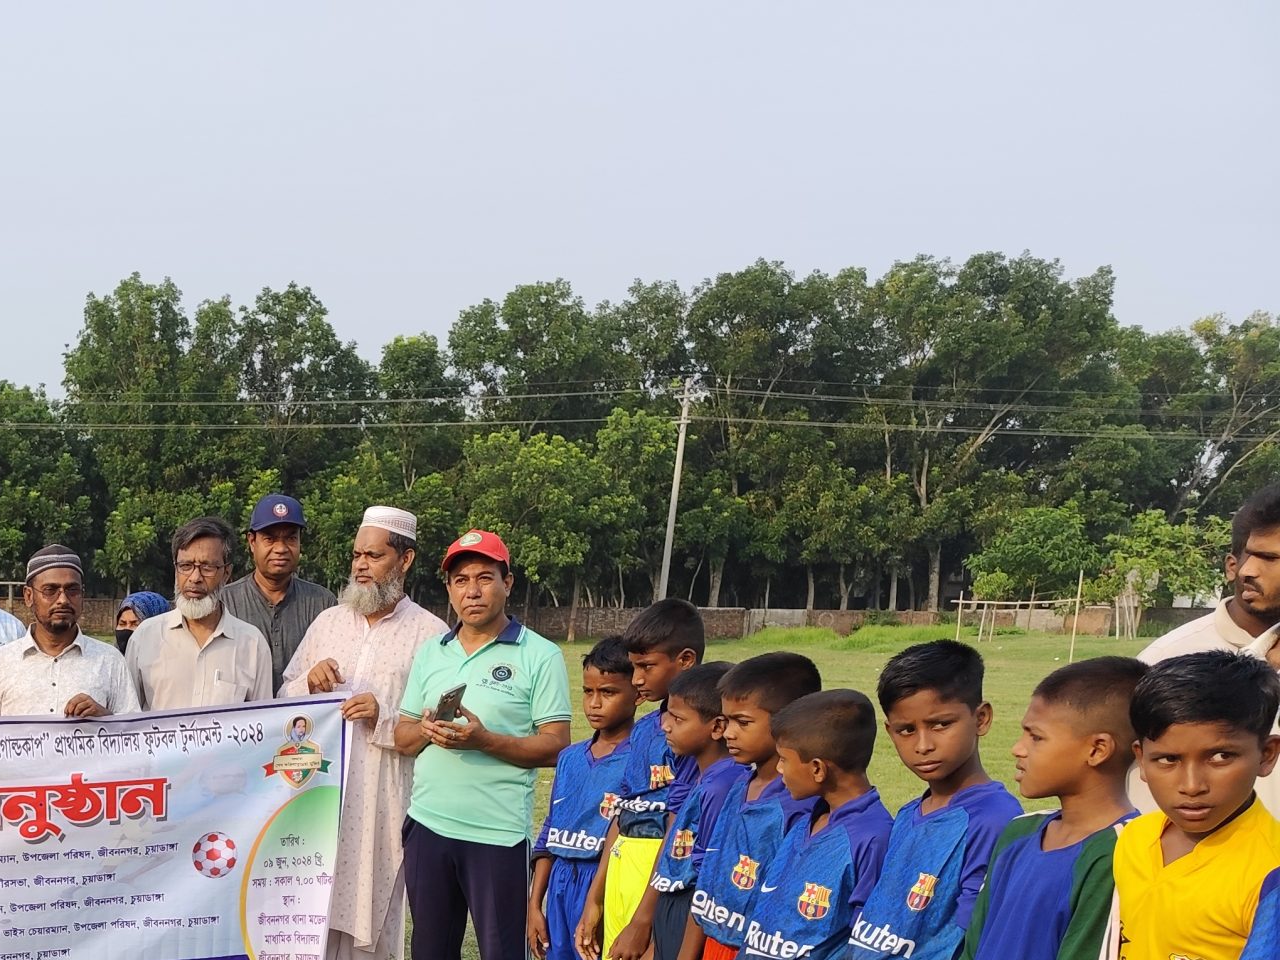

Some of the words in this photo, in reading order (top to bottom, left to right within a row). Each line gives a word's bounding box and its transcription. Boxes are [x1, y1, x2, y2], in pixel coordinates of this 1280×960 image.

[55, 729, 95, 756] প্রাথমিক
[98, 728, 140, 754] বিদ্যালয়
[144, 724, 177, 755] ফুটবল
[179, 719, 222, 753] টুর্নামেন্ট
[280, 834, 300, 847] তারিখ
[23, 851, 59, 862] উপজেলা
[63, 849, 94, 861] পরিষদ,
[97, 847, 142, 859] জীবননগর,
[292, 855, 312, 867] ২০২৪
[33, 876, 79, 887] জীবননগর,
[274, 875, 293, 887] সকাল
[10, 902, 46, 913] উপজেলা
[50, 899, 80, 911] পরিষদ,
[83, 896, 128, 908] জীবননগর,
[258, 912, 290, 926] জীবননগর
[3, 926, 25, 938] ভাইস
[74, 920, 107, 931] উপজেলা
[110, 919, 140, 930] পরিষদ,
[143, 917, 185, 929] জীবননগর,
